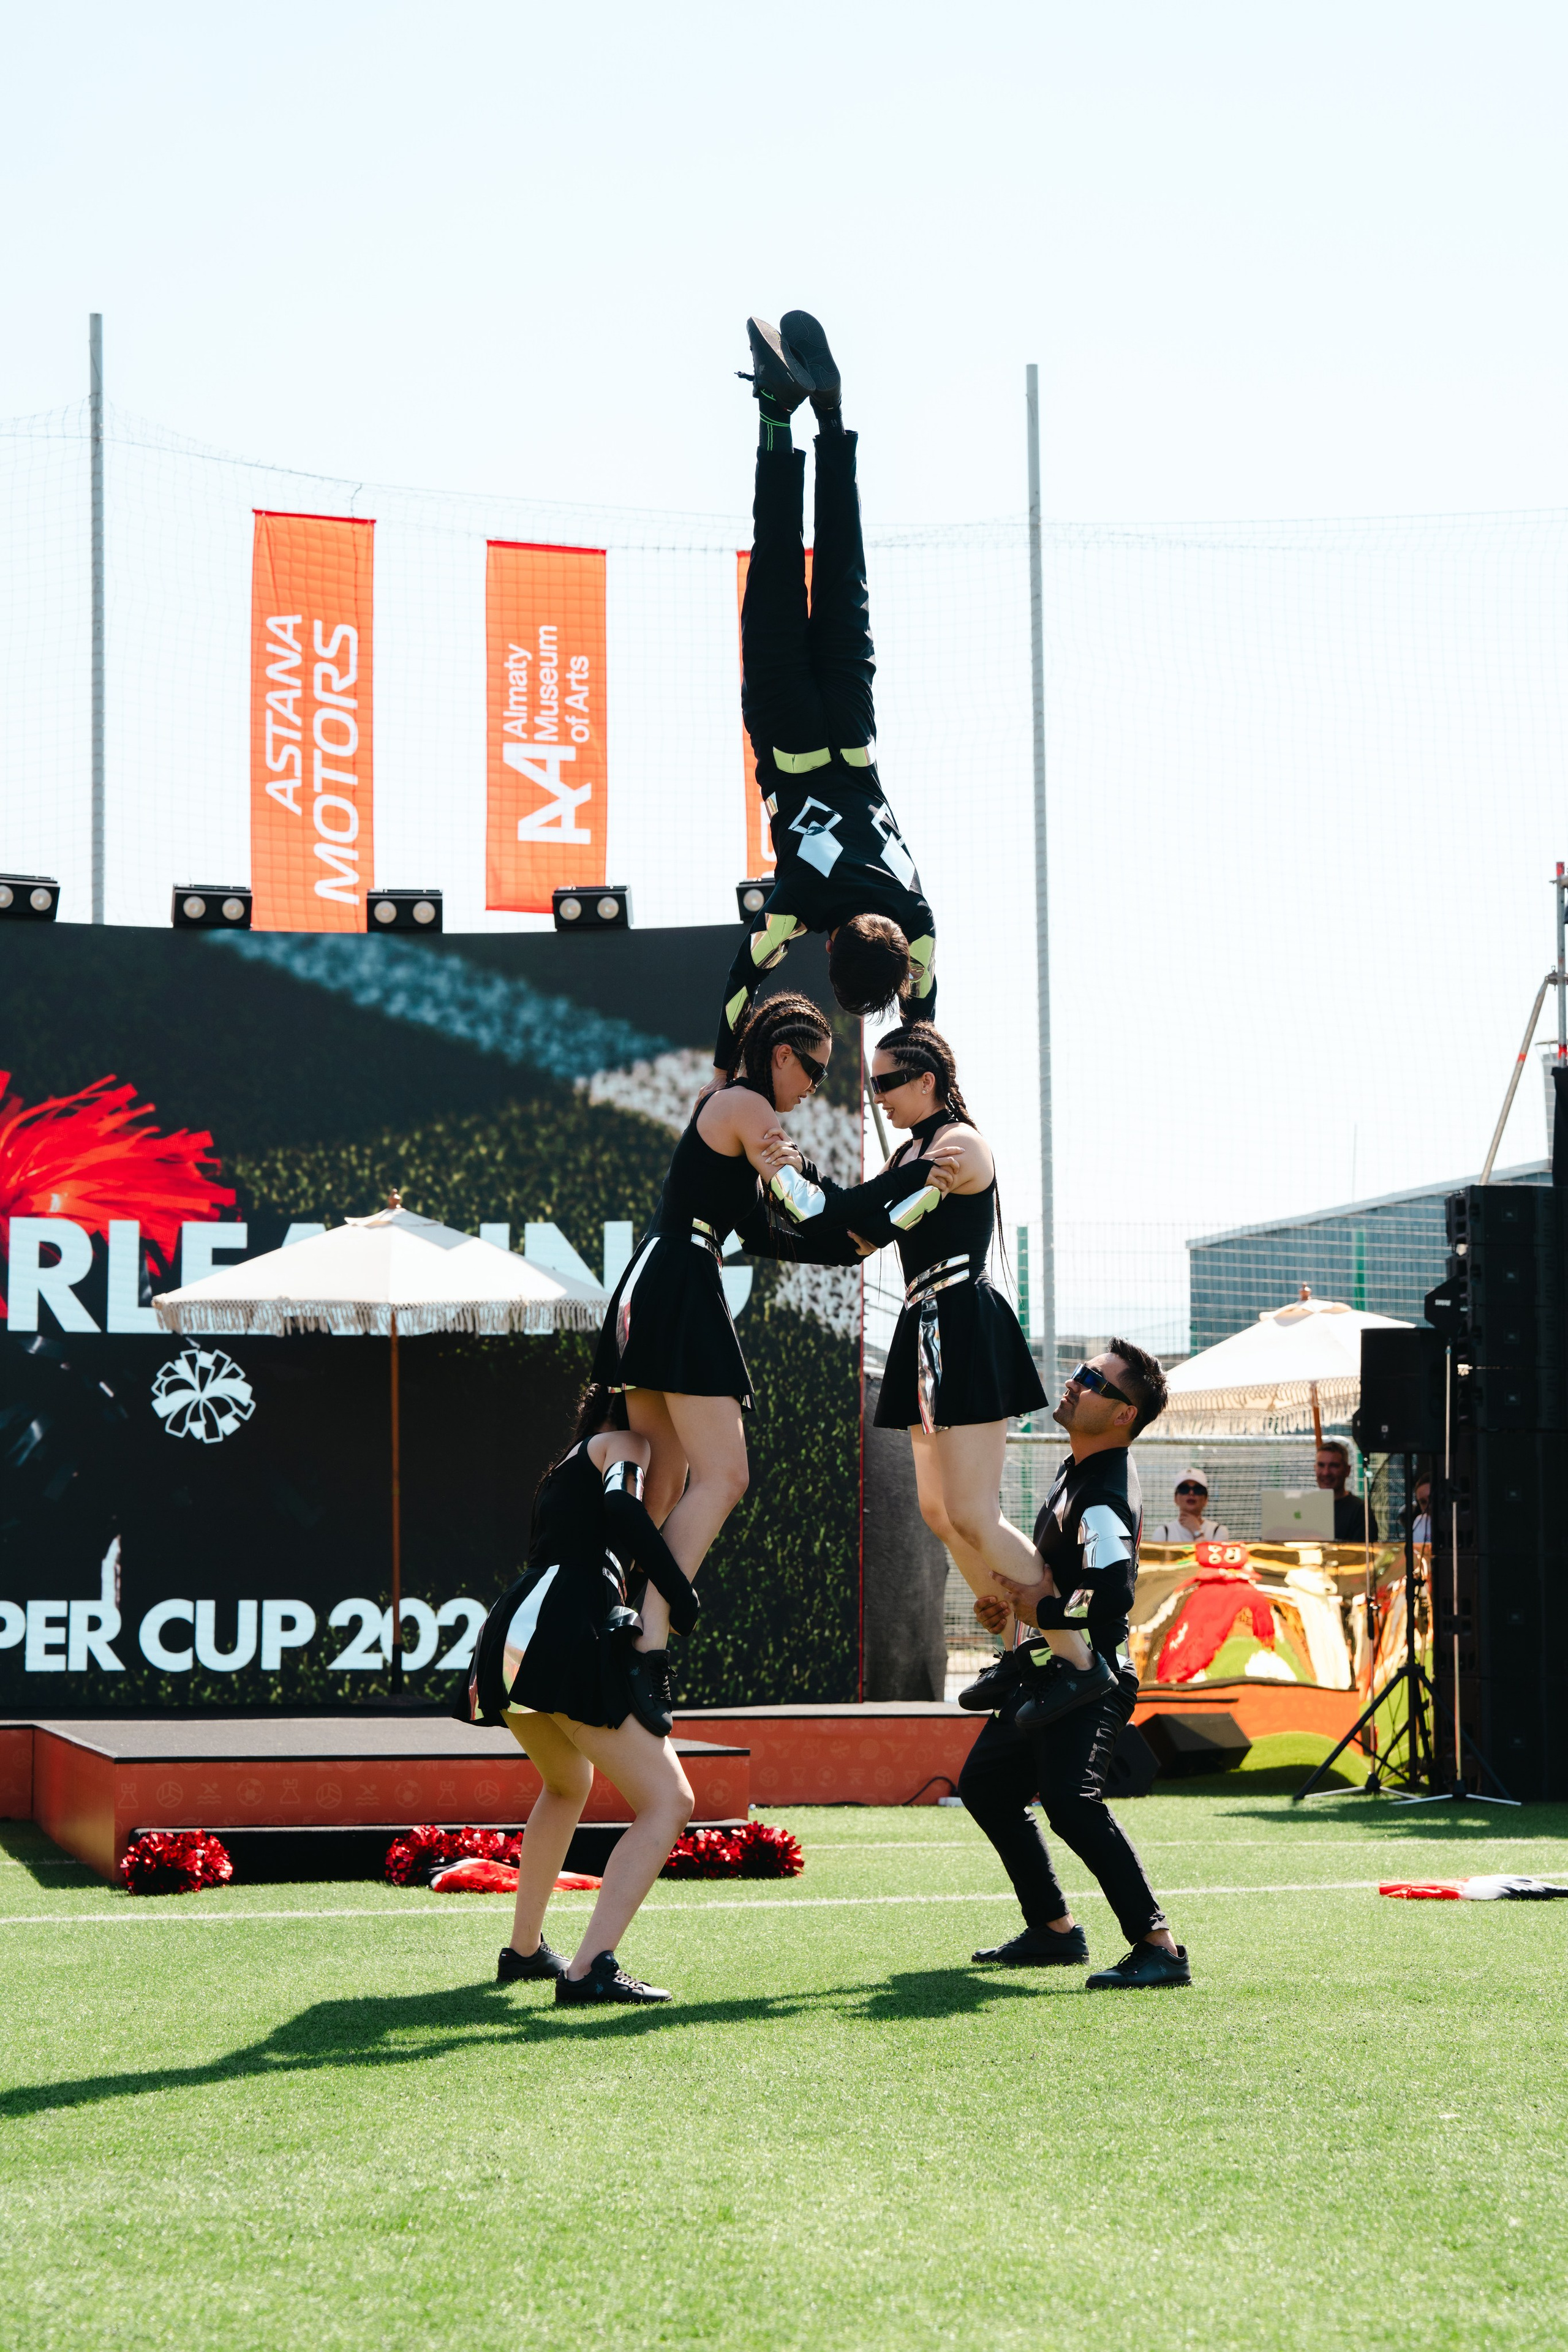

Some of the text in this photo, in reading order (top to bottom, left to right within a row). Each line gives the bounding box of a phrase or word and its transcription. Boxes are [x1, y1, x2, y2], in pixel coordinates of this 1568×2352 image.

[265, 614, 302, 816] ASTANA
[503, 643, 532, 739] Almaty
[533, 625, 559, 742] Museum
[565, 655, 590, 743] of Arts
[313, 619, 360, 905] MOTORS
[139, 1598, 316, 1672] CUP
